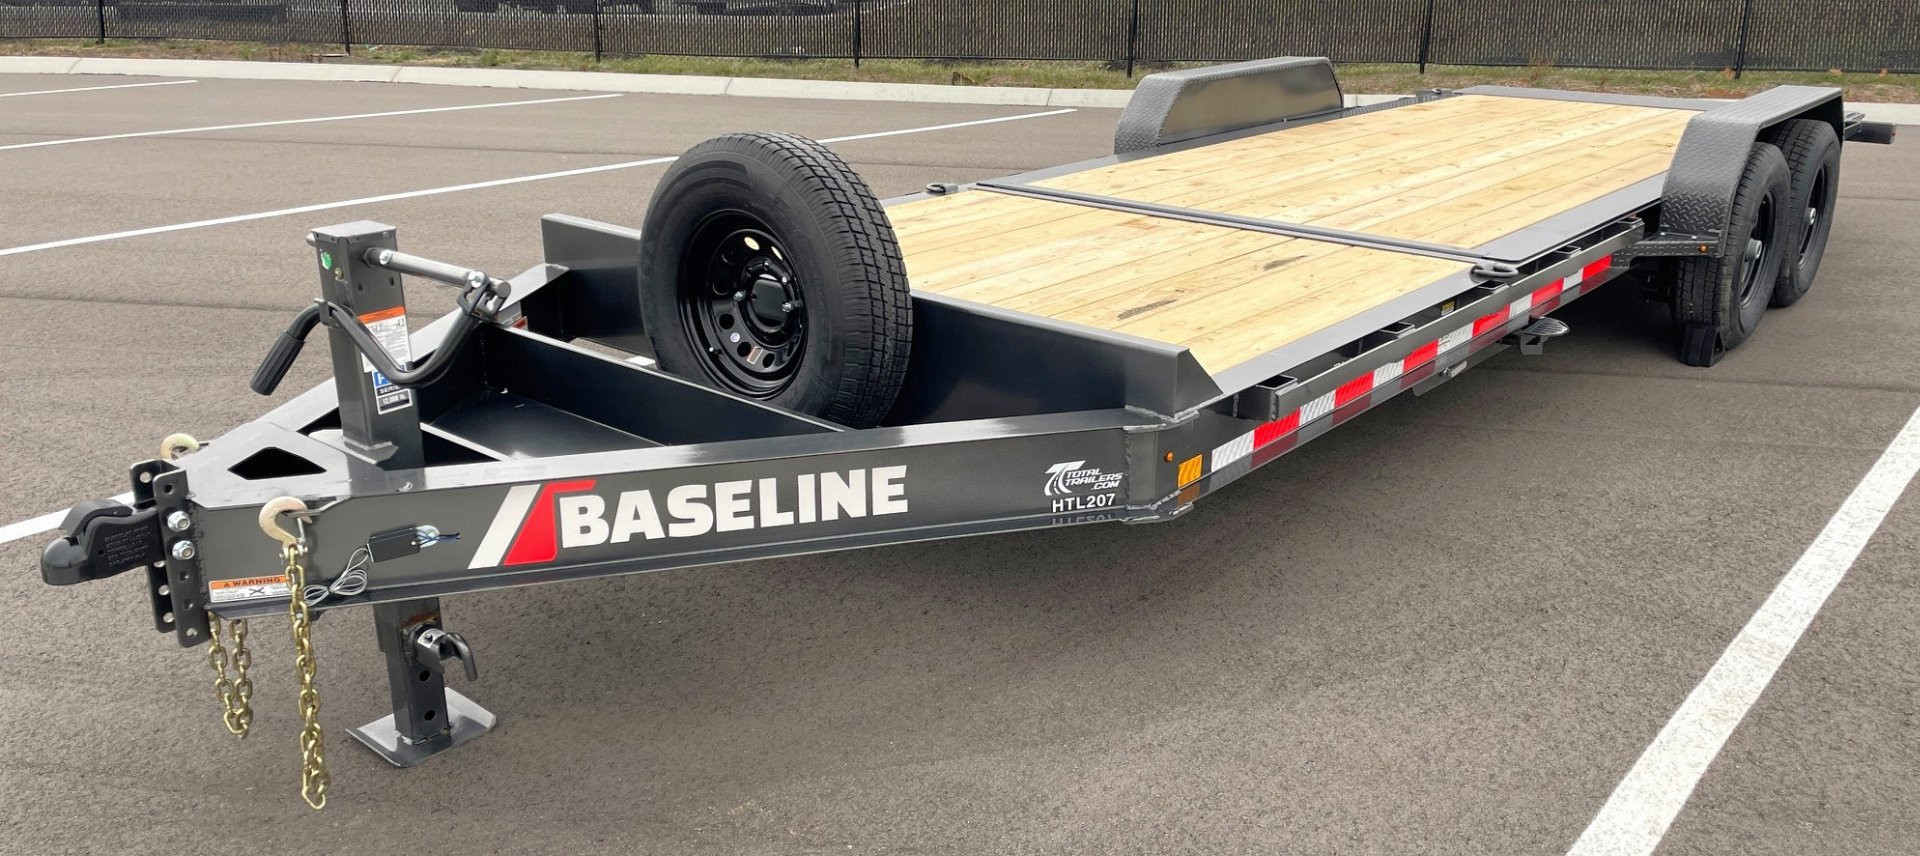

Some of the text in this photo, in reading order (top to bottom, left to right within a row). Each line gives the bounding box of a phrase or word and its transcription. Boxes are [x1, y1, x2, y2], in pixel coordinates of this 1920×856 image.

[1065, 472, 1124, 487] TRAILERS
[1066, 468, 1102, 479] TOTAL
[1091, 480, 1120, 490] .COM
[559, 465, 908, 548] BASELINE
[1052, 493, 1116, 513] HTL207
[232, 577, 281, 587] WARNING
